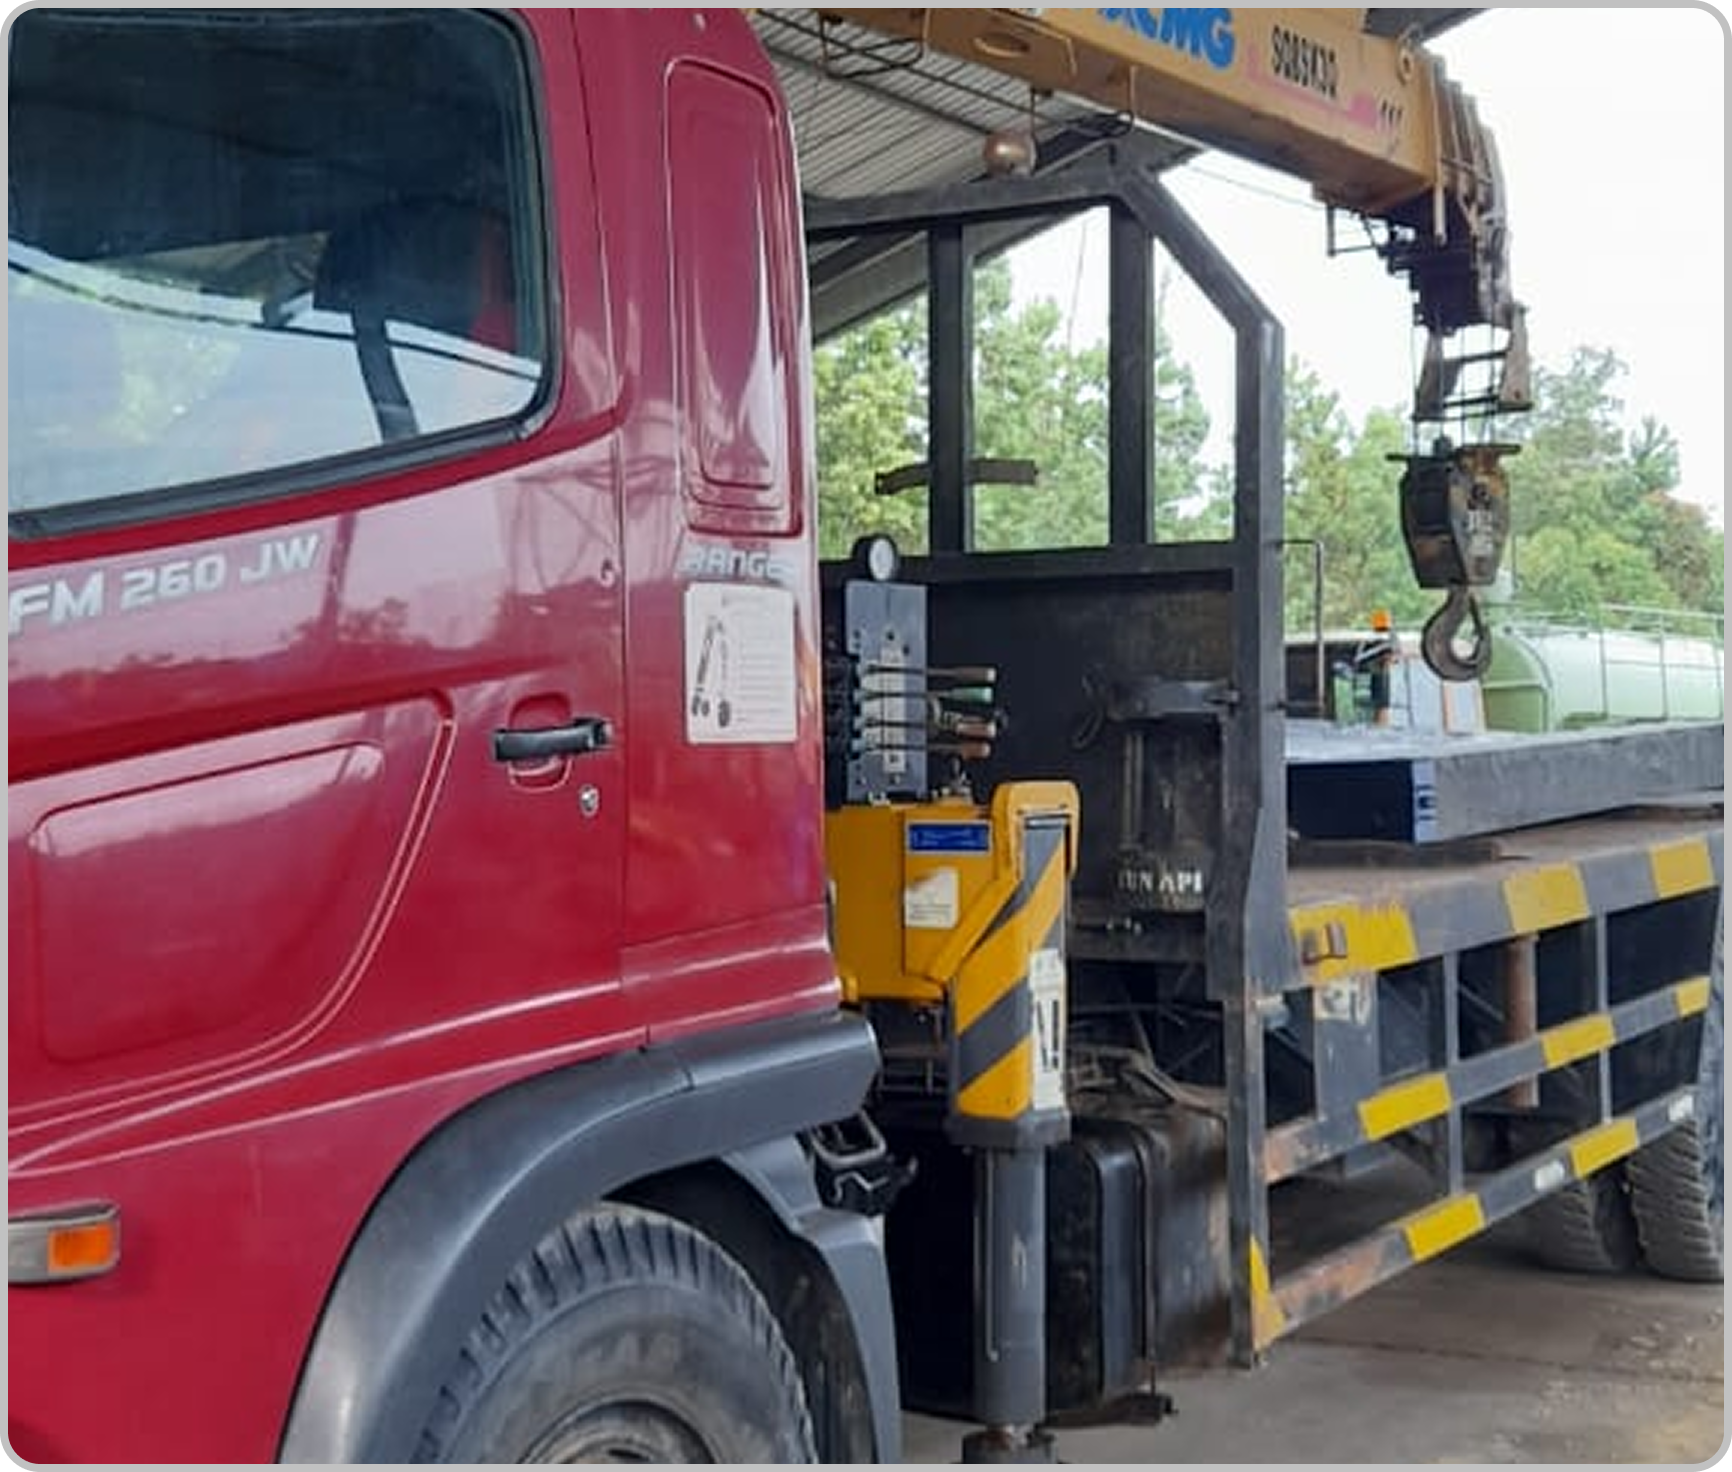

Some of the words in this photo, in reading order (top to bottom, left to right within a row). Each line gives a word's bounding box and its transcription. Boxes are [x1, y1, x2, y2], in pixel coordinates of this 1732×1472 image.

[9, 572, 104, 634] FM
[120, 554, 226, 609] 260
[240, 534, 318, 582] JW
